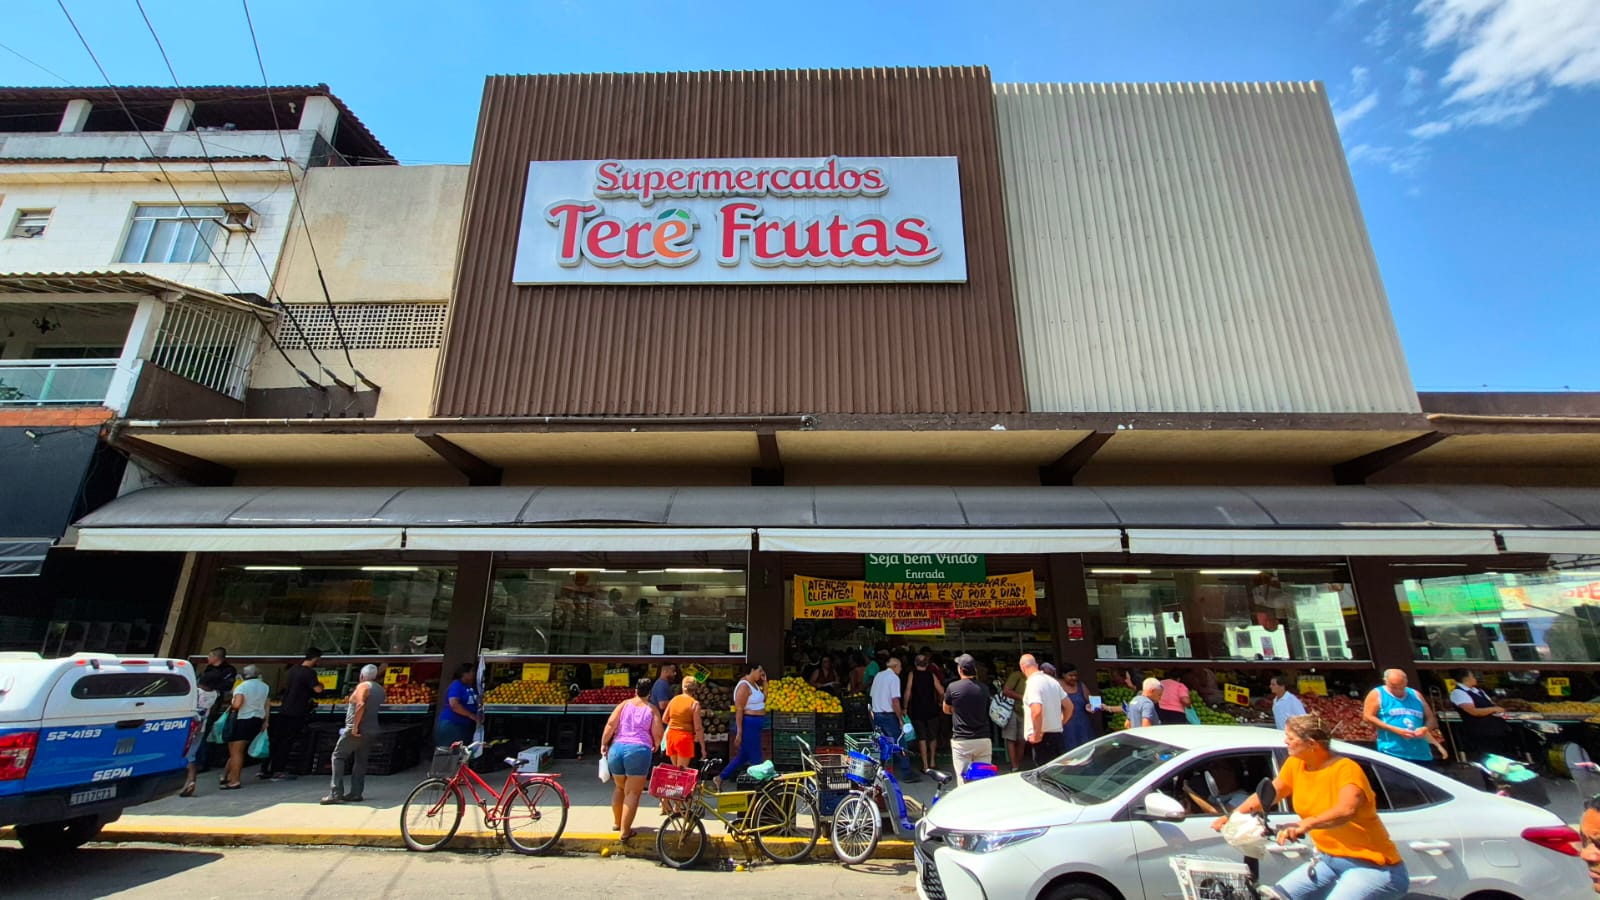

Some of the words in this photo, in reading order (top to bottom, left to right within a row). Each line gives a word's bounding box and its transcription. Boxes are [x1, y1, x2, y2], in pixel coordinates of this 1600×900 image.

[595, 158, 883, 198] Supermercados
[720, 202, 938, 258] Frutas
[869, 553, 900, 568] Seja
[903, 553, 933, 565] bem
[935, 553, 978, 565] Vindo
[905, 568, 945, 579] Entrada
[863, 589, 890, 600] MAIS
[968, 588, 986, 599] POR
[990, 588, 998, 599] 2
[810, 609, 821, 618] NO
[91, 766, 134, 782] SEPM
